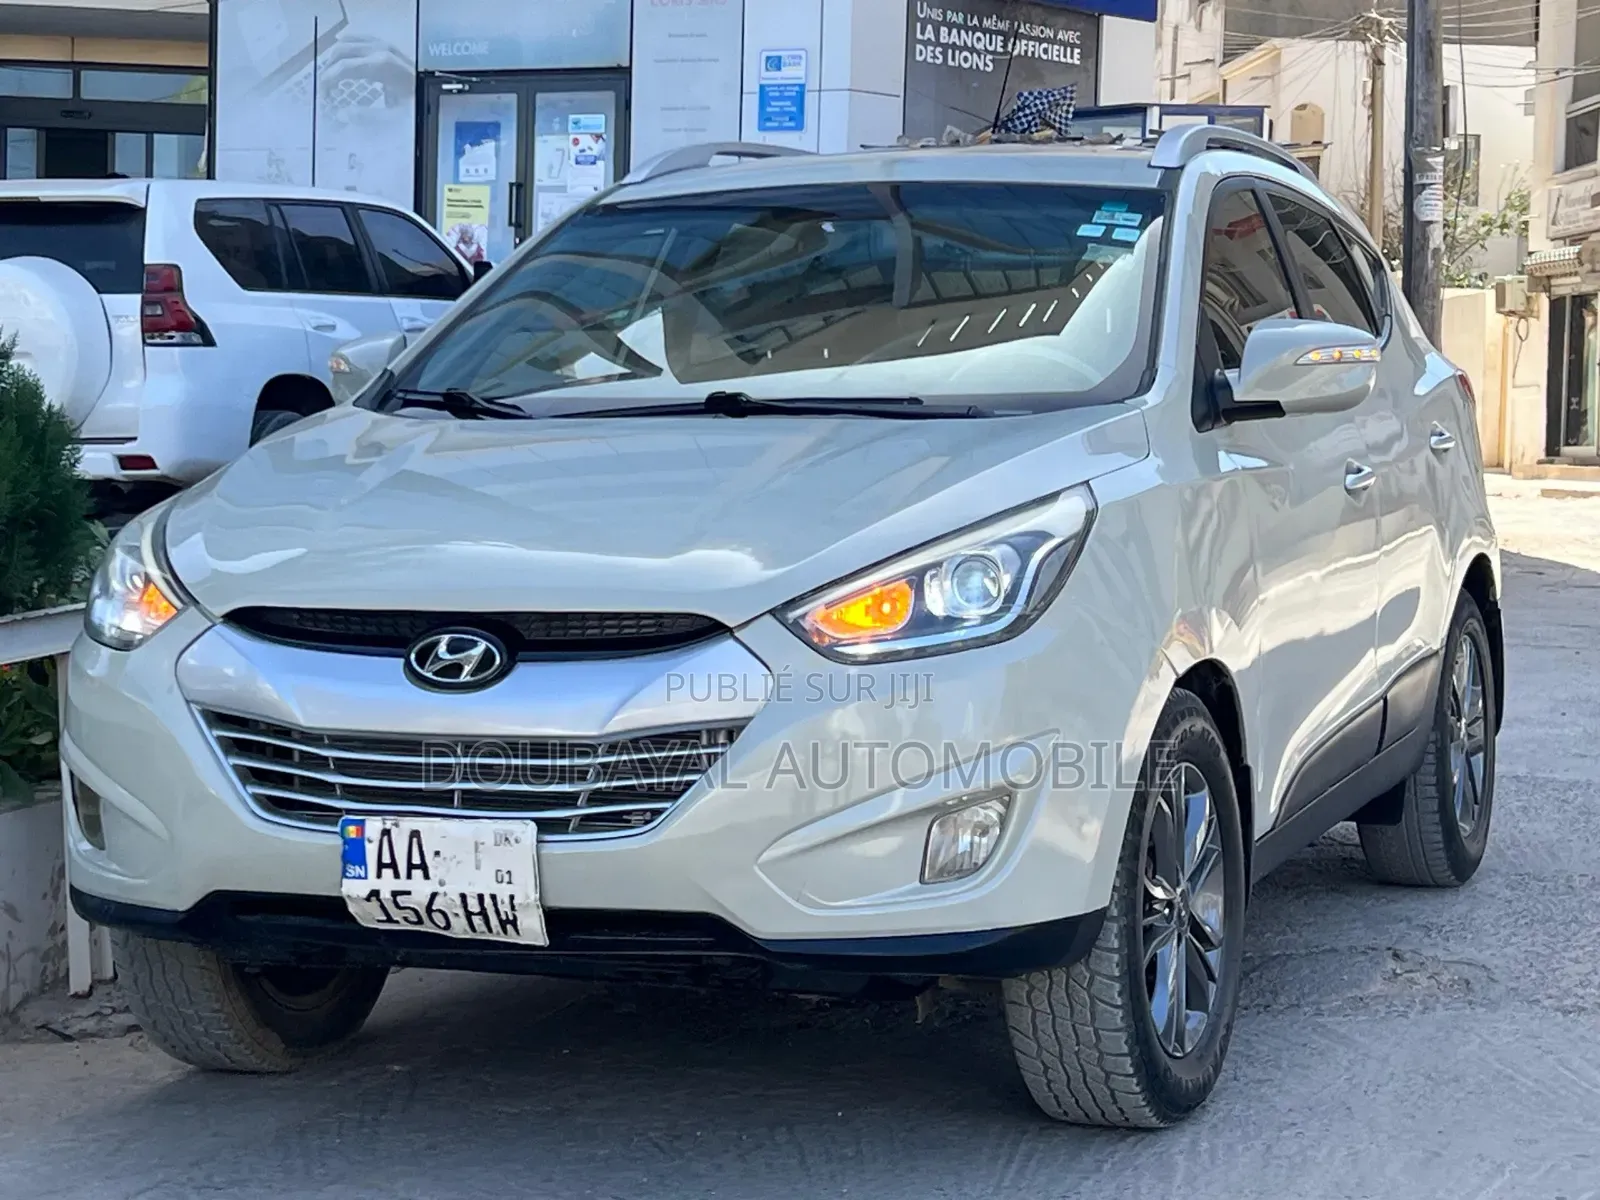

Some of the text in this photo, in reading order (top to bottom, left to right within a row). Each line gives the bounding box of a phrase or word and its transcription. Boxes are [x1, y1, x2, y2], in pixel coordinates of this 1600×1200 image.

[946, 10, 964, 25] PAR
[967, 14, 979, 27] LA
[1057, 29, 1081, 44] AVEC
[428, 40, 489, 56] WELCOME
[916, 22, 1081, 65] LA BANQUE OFFICIELLE
[916, 44, 994, 72] DES LIONS
[376, 828, 431, 880] AA
[345, 865, 368, 878] SN
[495, 869, 514, 885] 01
[365, 889, 521, 936] 156 HW
